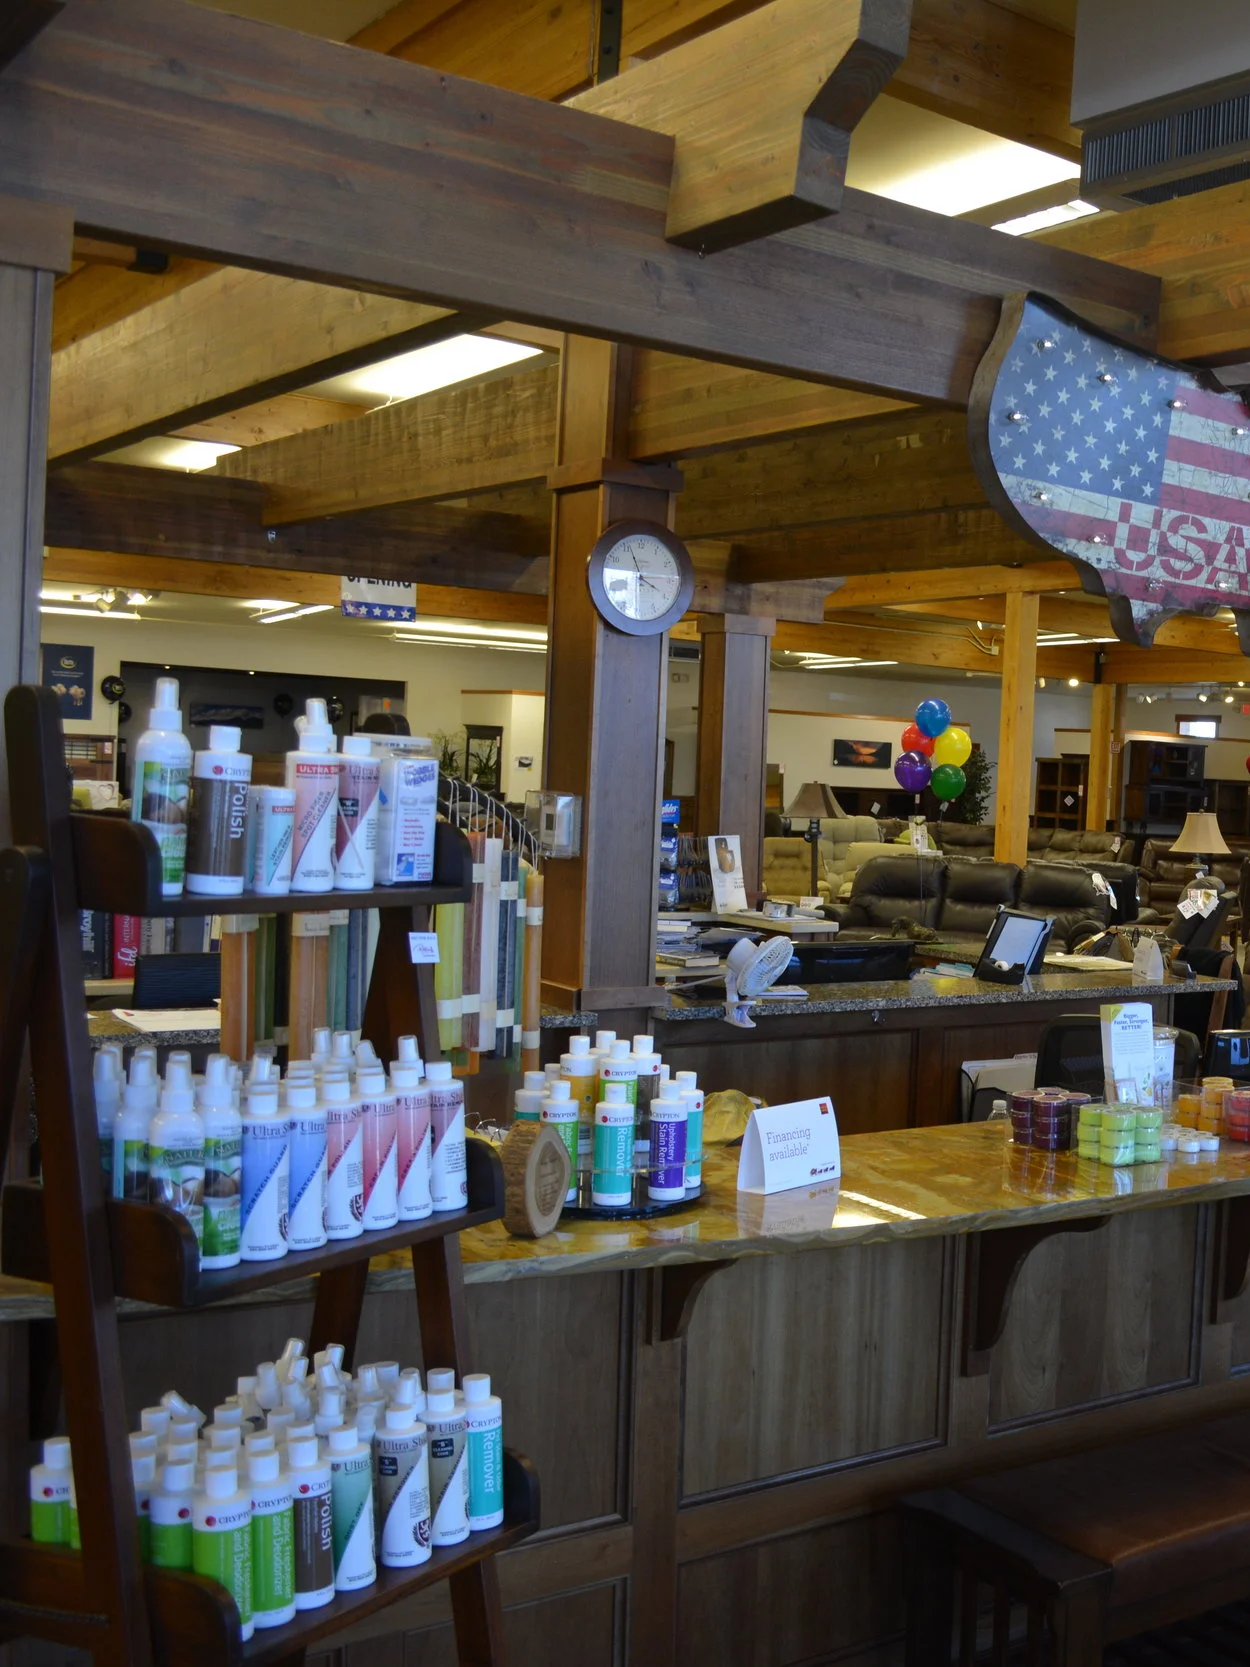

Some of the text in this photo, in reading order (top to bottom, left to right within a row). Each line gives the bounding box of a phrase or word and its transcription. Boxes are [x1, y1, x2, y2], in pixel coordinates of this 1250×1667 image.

[1111, 501, 1249, 592] USA
[299, 764, 329, 774] ULTRA
[229, 782, 249, 839] Polish
[252, 1125, 282, 1137] Ultra
[300, 1121, 325, 1134] Ultra
[668, 1123, 677, 1161] Upholstery
[766, 1128, 811, 1145] Financing
[615, 1127, 628, 1178] Remover
[657, 1123, 669, 1185] Stain Remver
[245, 1174, 271, 1217] SCRATCH
[383, 1439, 410, 1451] Ultra
[438, 1422, 464, 1434] Ultra
[344, 1461, 369, 1474] Ultra
[483, 1431, 495, 1493] Remover
[321, 1493, 333, 1552] Polish
